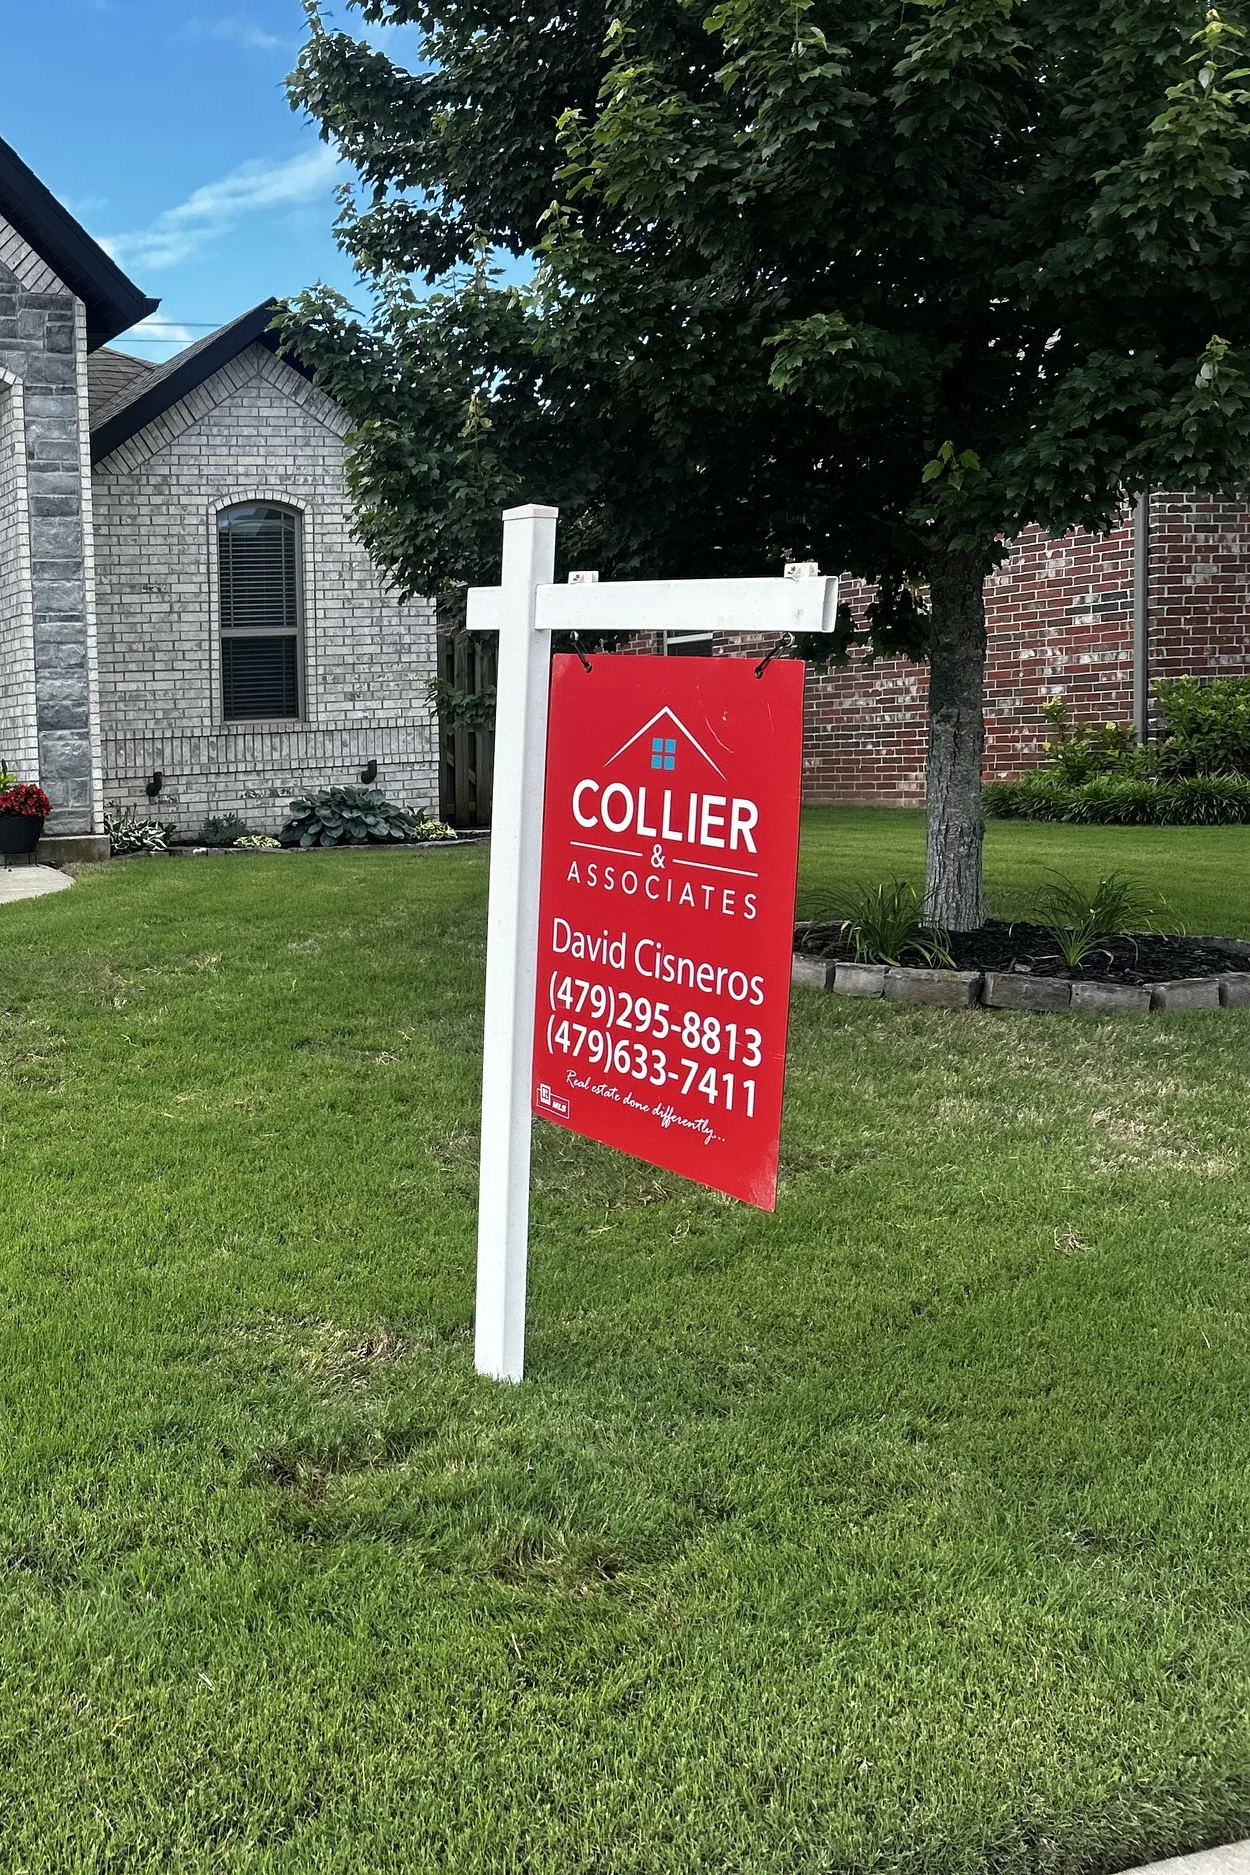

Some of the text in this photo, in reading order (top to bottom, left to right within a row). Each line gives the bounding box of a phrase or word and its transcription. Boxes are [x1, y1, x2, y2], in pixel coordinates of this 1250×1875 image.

[571, 778, 759, 854] COLLIER
[566, 860, 758, 921] ASSOCIATES
[650, 843, 666, 869] &
[551, 917, 764, 1006] David Cisneros
[549, 970, 762, 1068] (479)295-8813
[546, 1014, 756, 1118] (479)633-7411
[566, 1069, 590, 1090] Real
[591, 1083, 621, 1102] estate
[622, 1091, 650, 1112] done
